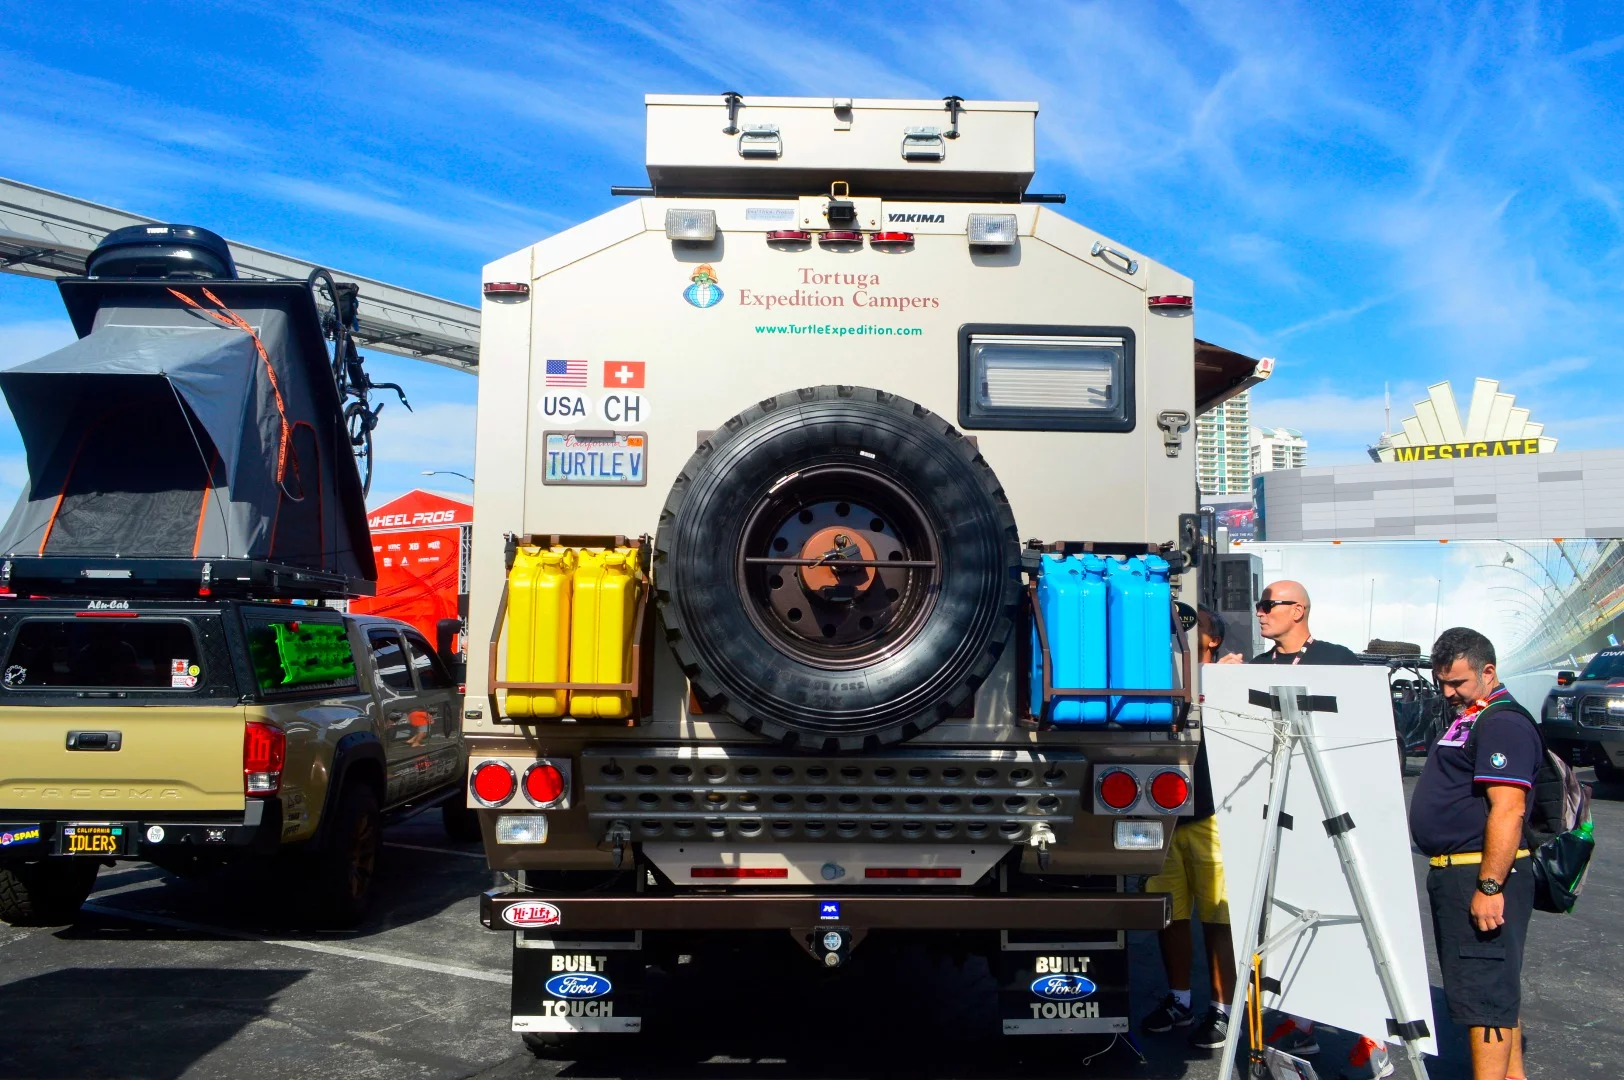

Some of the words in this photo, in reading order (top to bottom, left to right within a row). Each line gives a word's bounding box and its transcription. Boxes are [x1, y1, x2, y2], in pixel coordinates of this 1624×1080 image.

[888, 214, 945, 223] YAKIMA
[798, 267, 880, 289] Tortuga
[739, 288, 845, 310] Expedition
[852, 290, 939, 312] Campers
[755, 324, 923, 337] www.TurtleExpedition.com
[544, 396, 586, 416] USA
[604, 395, 640, 422] CH
[1396, 439, 1537, 462] WESTGATE
[548, 451, 624, 477] TURTLE
[629, 452, 641, 477] V
[412, 510, 455, 524] PROS
[87, 600, 129, 610] Alu-Cab
[13, 788, 183, 799] TACOMA
[14, 829, 40, 840] SPAM
[69, 835, 117, 851] IDLERS
[513, 907, 551, 920] Hi-Lift
[551, 955, 608, 972] BUILT
[1036, 957, 1090, 973] BUILT
[558, 976, 598, 994] Ford
[1044, 977, 1082, 995] Ford
[542, 1000, 614, 1017] TOUGH
[1030, 1002, 1099, 1018] TOUGH
